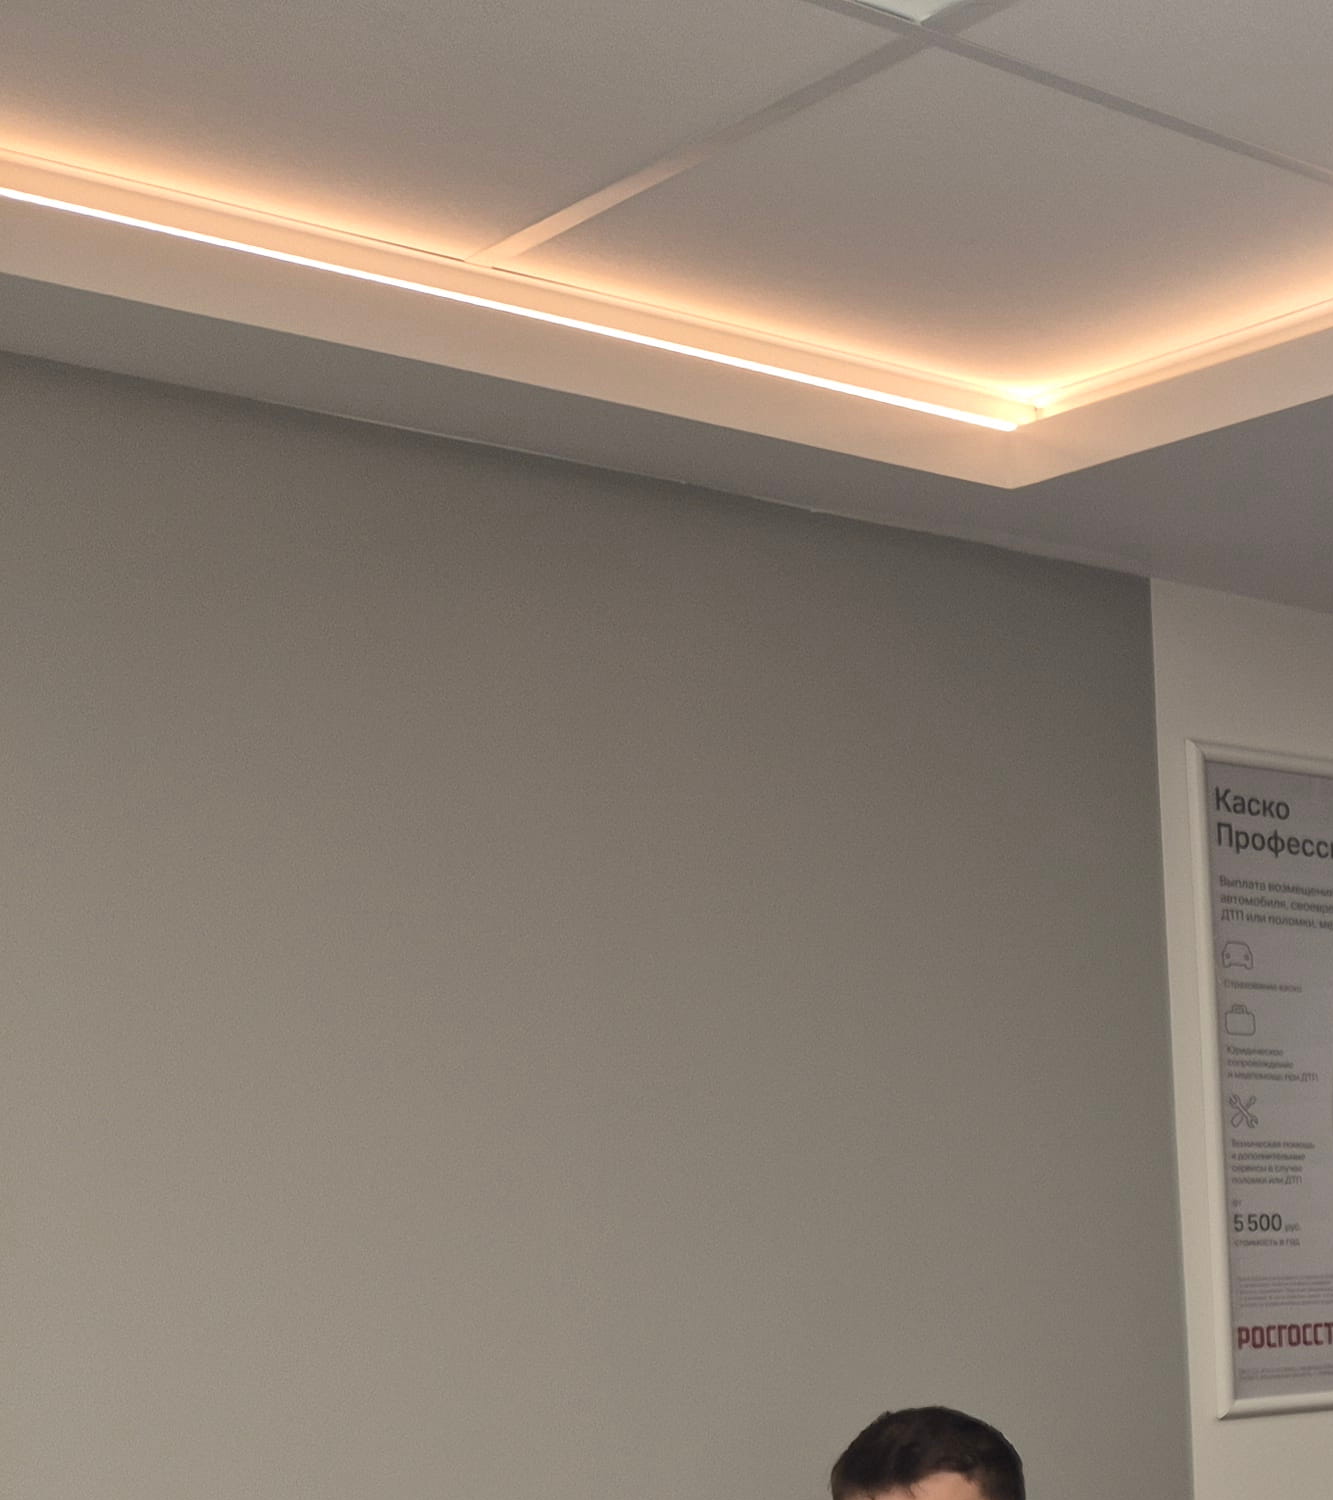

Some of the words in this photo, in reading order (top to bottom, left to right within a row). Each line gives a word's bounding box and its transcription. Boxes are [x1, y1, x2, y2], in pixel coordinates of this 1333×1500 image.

[1214, 787, 1290, 821] Каско
[1220, 908, 1244, 921] ДТП
[1233, 1213, 1244, 1232] 5
[1247, 1213, 1282, 1232] 500
